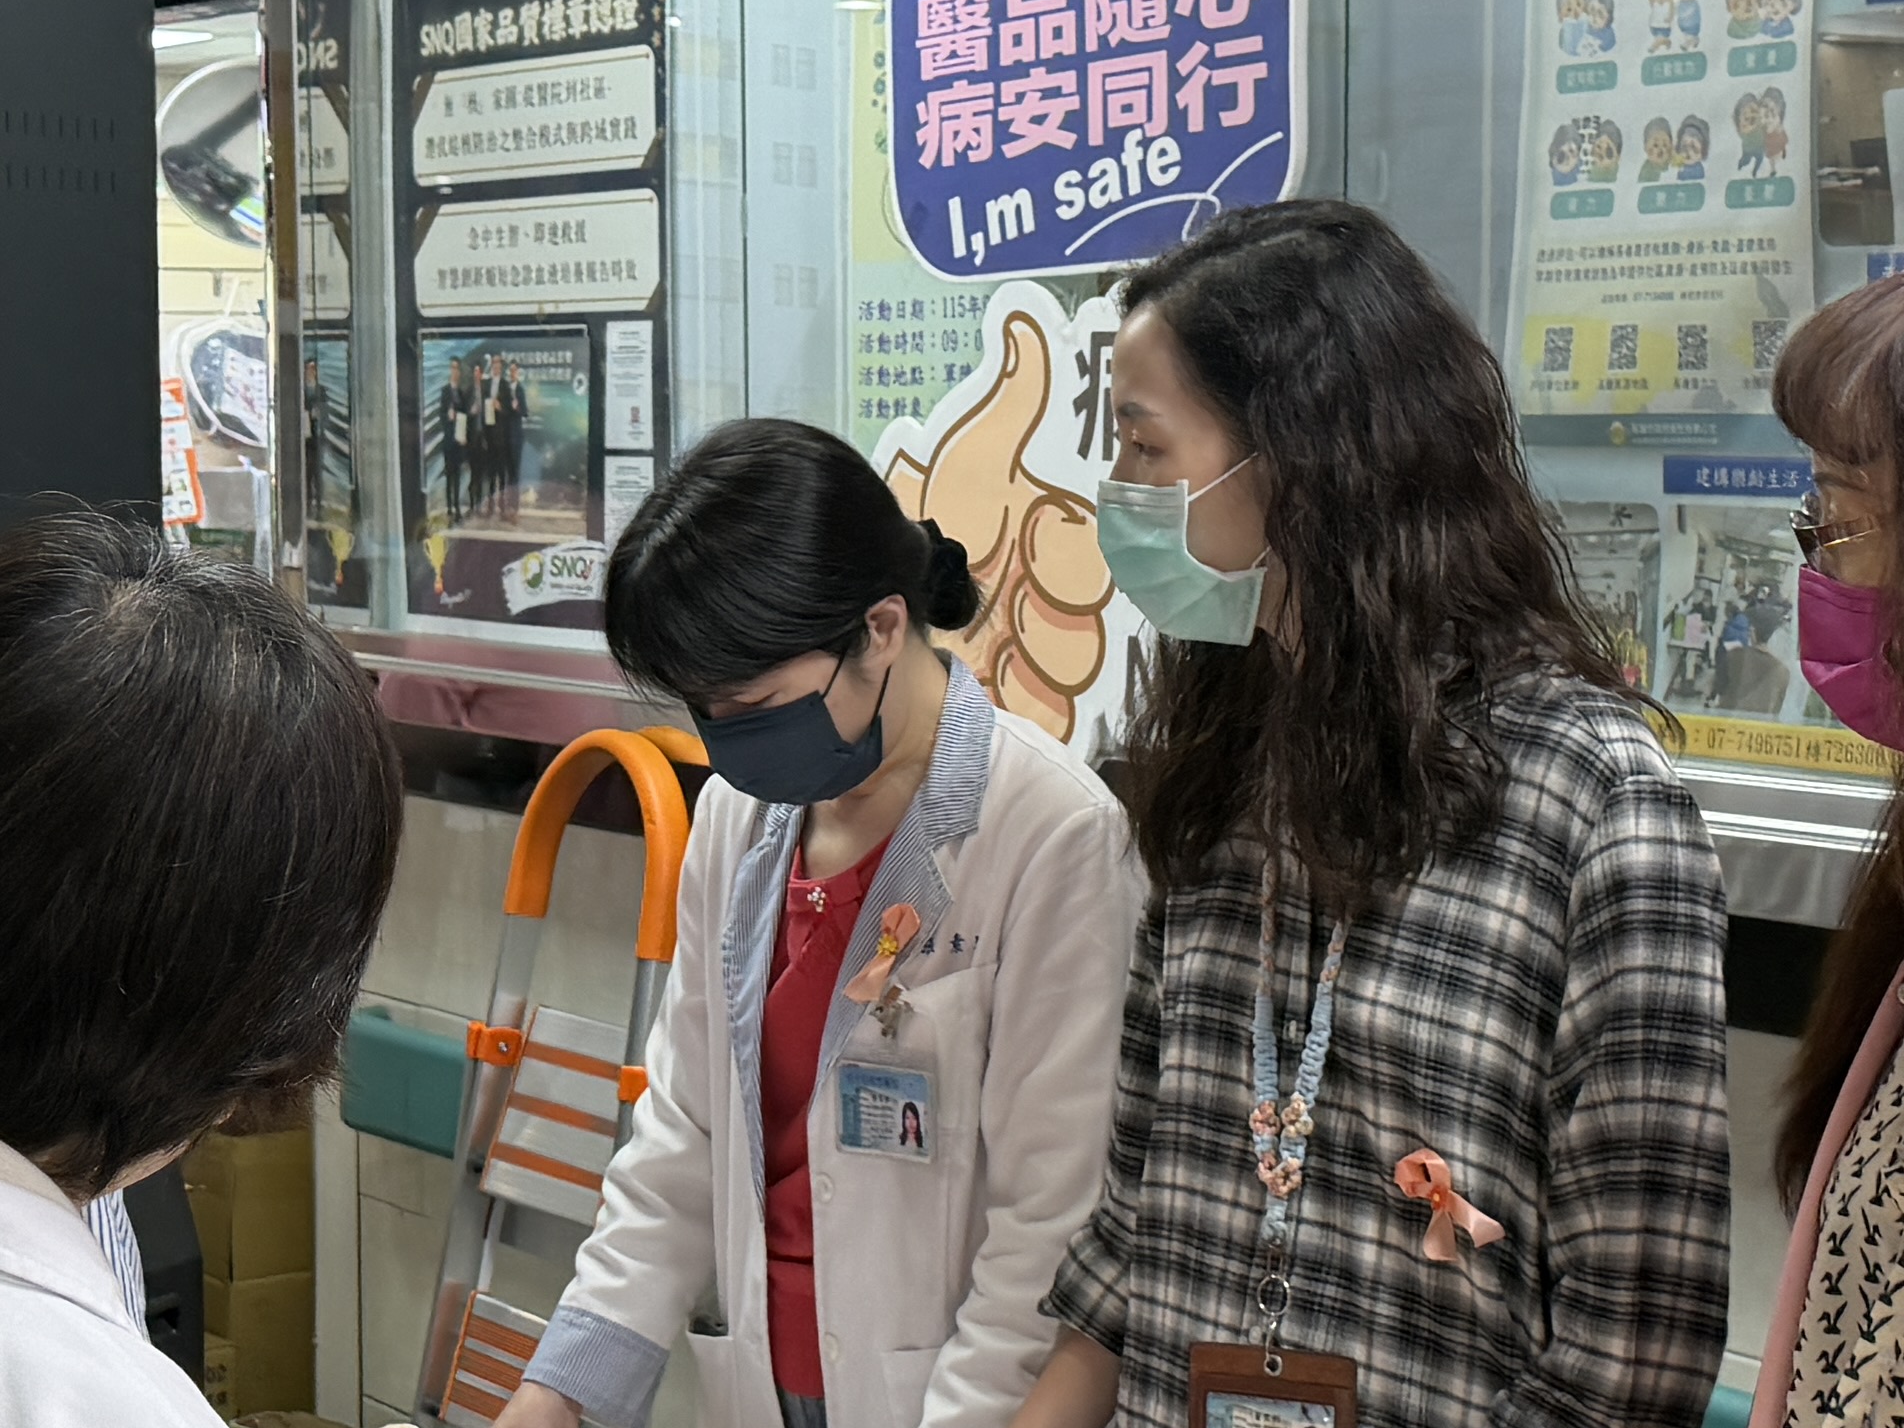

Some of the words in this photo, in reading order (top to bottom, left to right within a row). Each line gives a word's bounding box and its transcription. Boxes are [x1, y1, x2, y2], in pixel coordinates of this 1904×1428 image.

[915, 35, 1269, 171] 病安同行
[947, 189, 1035, 267] I,m
[1053, 127, 1182, 223] safe
